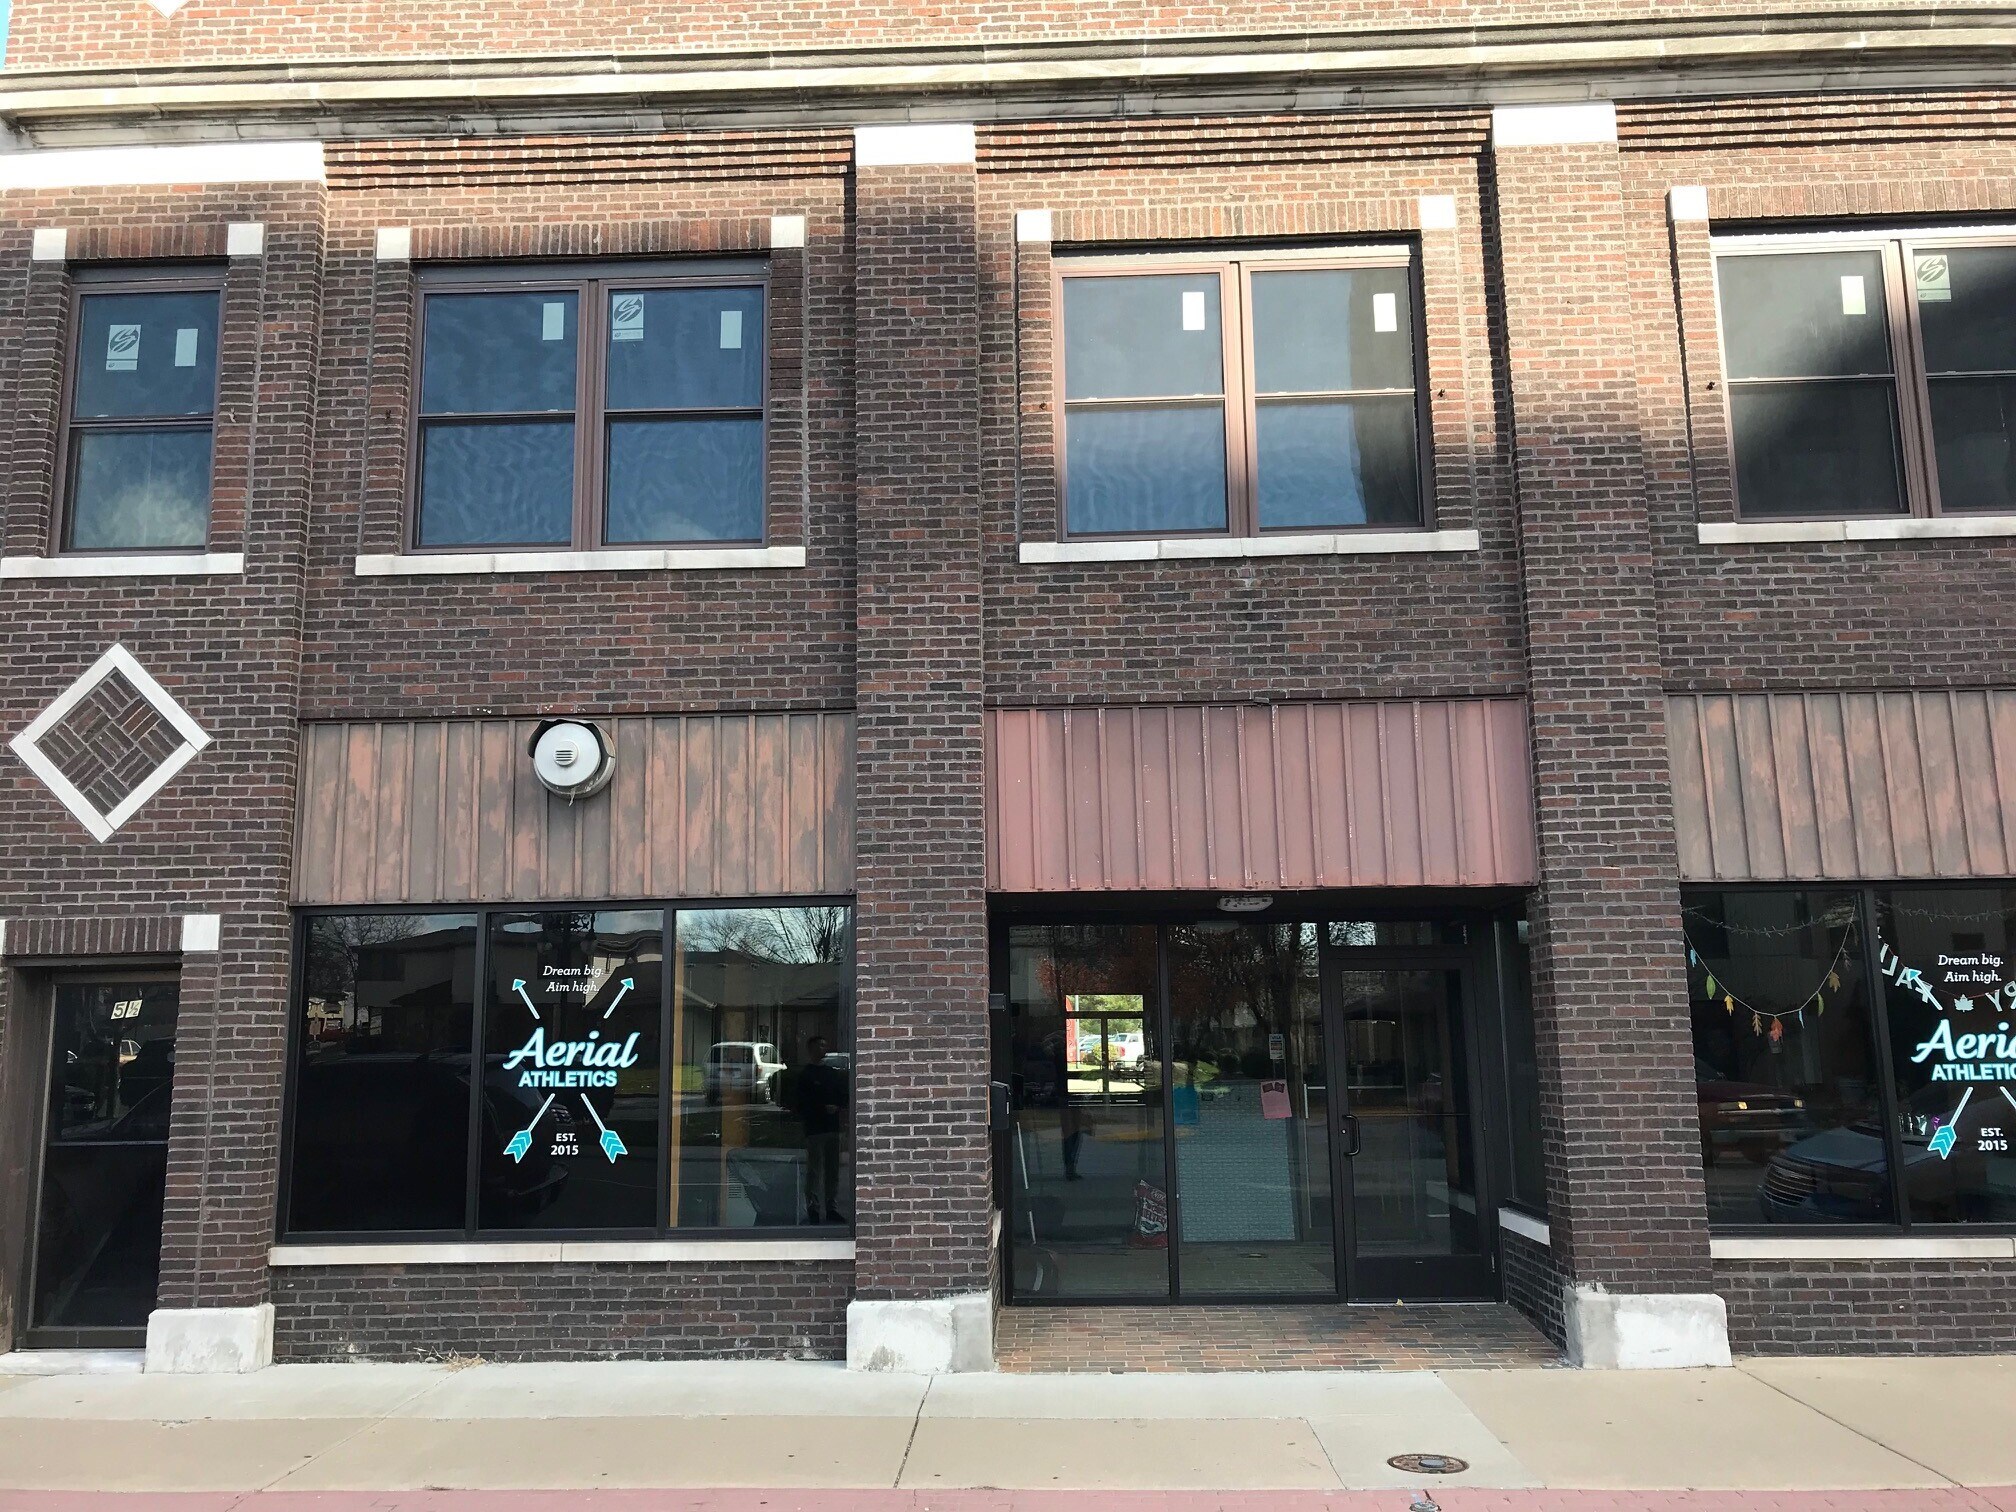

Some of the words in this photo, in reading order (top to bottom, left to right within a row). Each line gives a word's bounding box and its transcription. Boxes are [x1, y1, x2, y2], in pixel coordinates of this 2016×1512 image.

[1937, 954, 1980, 966] Dream
[1981, 953, 2004, 967] big.
[542, 965, 582, 977] Dream
[583, 964, 604, 979] big.
[1943, 971, 1970, 983] Aim
[1972, 969, 2003, 984] high.
[545, 981, 571, 993] Aim
[572, 981, 600, 995] high.
[502, 1026, 641, 1070] Aerial
[518, 1070, 618, 1087] ATHLETICS
[555, 1133, 577, 1142] EST.
[1980, 1128, 2004, 1137] EST.
[550, 1144, 579, 1156] 2015
[1977, 1140, 2008, 1151] 2015
